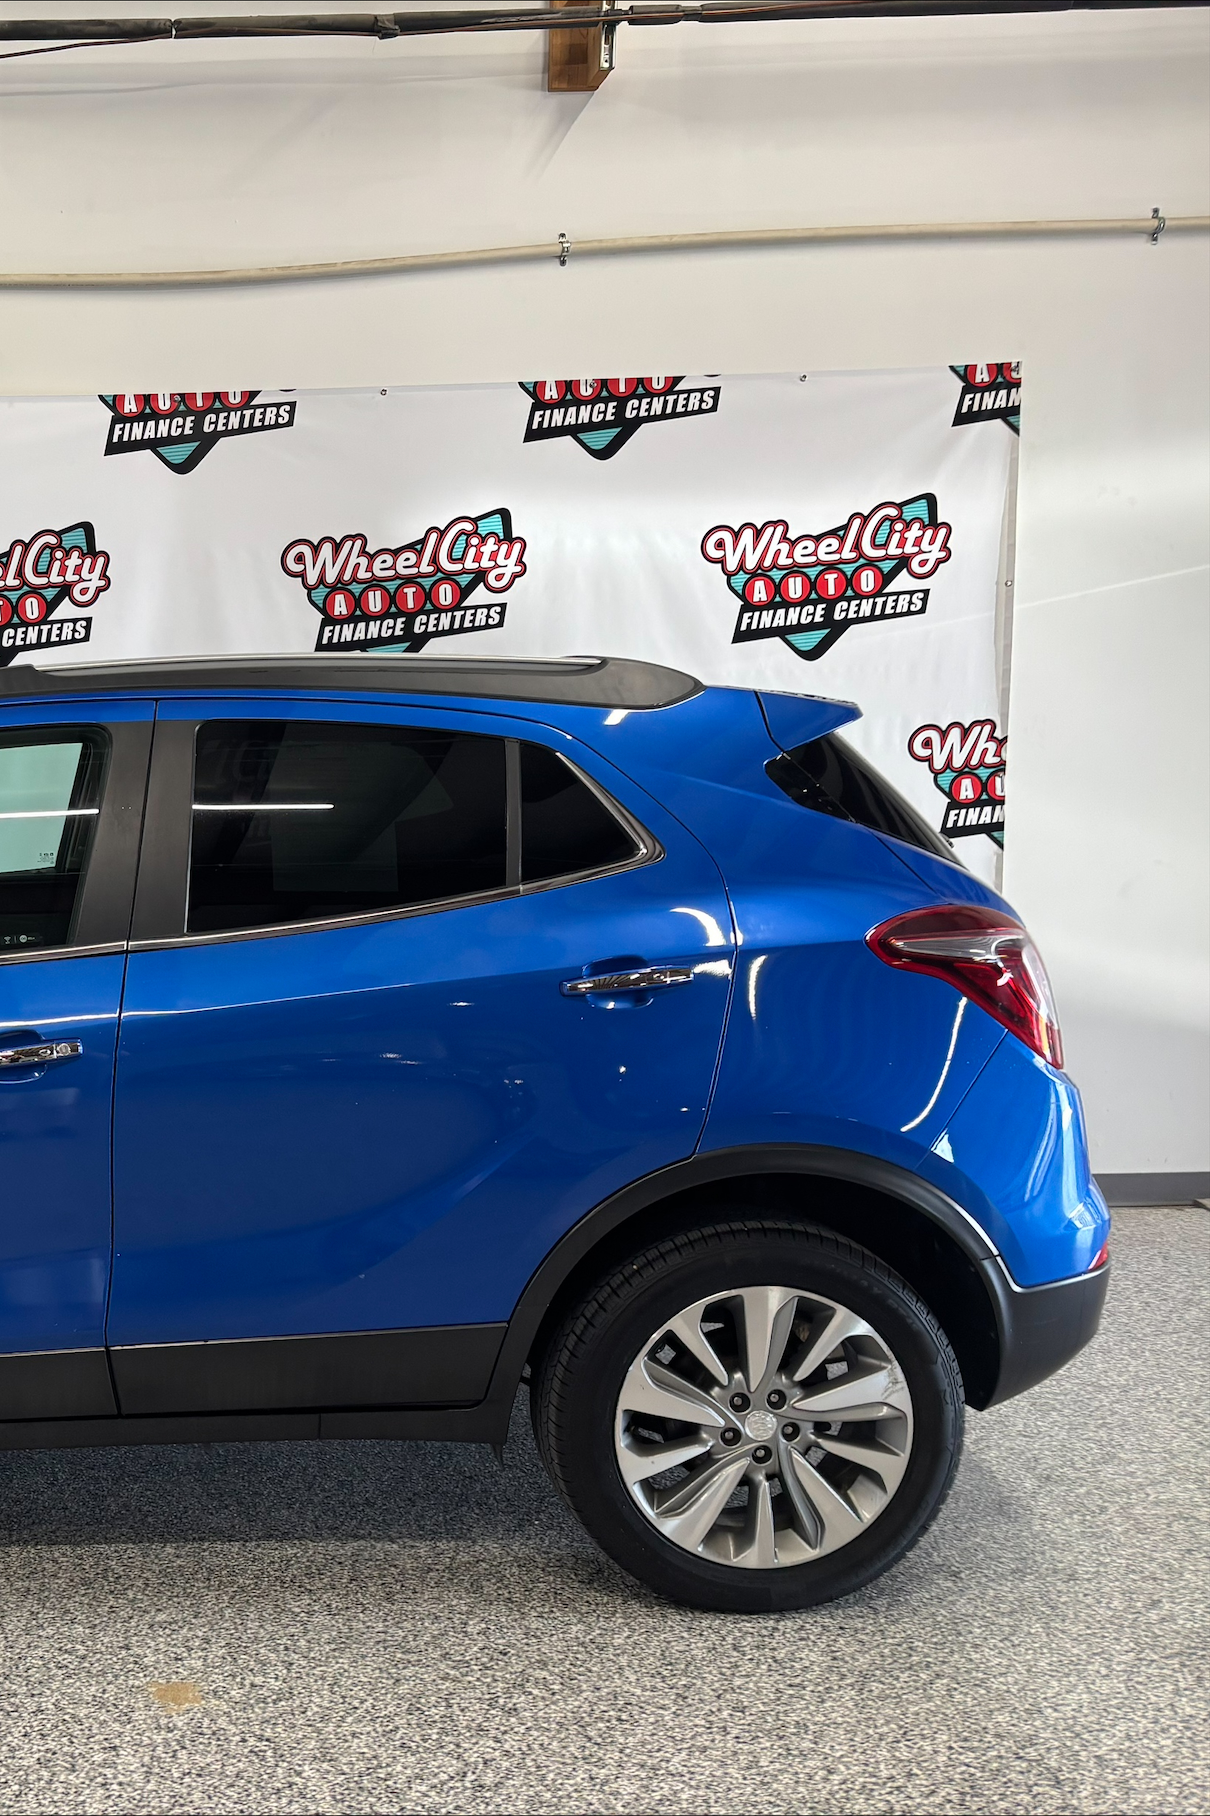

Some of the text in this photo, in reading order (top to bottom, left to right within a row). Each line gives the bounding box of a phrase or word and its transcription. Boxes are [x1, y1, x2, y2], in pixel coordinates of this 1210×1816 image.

[112, 404, 291, 443] FINANCE CENTERS
[532, 390, 715, 430] FINANCE CENTERS
[284, 520, 525, 590] Wheel City
[704, 505, 949, 576] Wheel City
[24, 534, 108, 604] City
[752, 569, 876, 602] AUTO
[333, 583, 452, 616] AUTO
[740, 591, 924, 631] FINANCE CENTERS
[1, 620, 87, 647] CENTERS
[321, 606, 501, 644] FINANCE CENTERS
